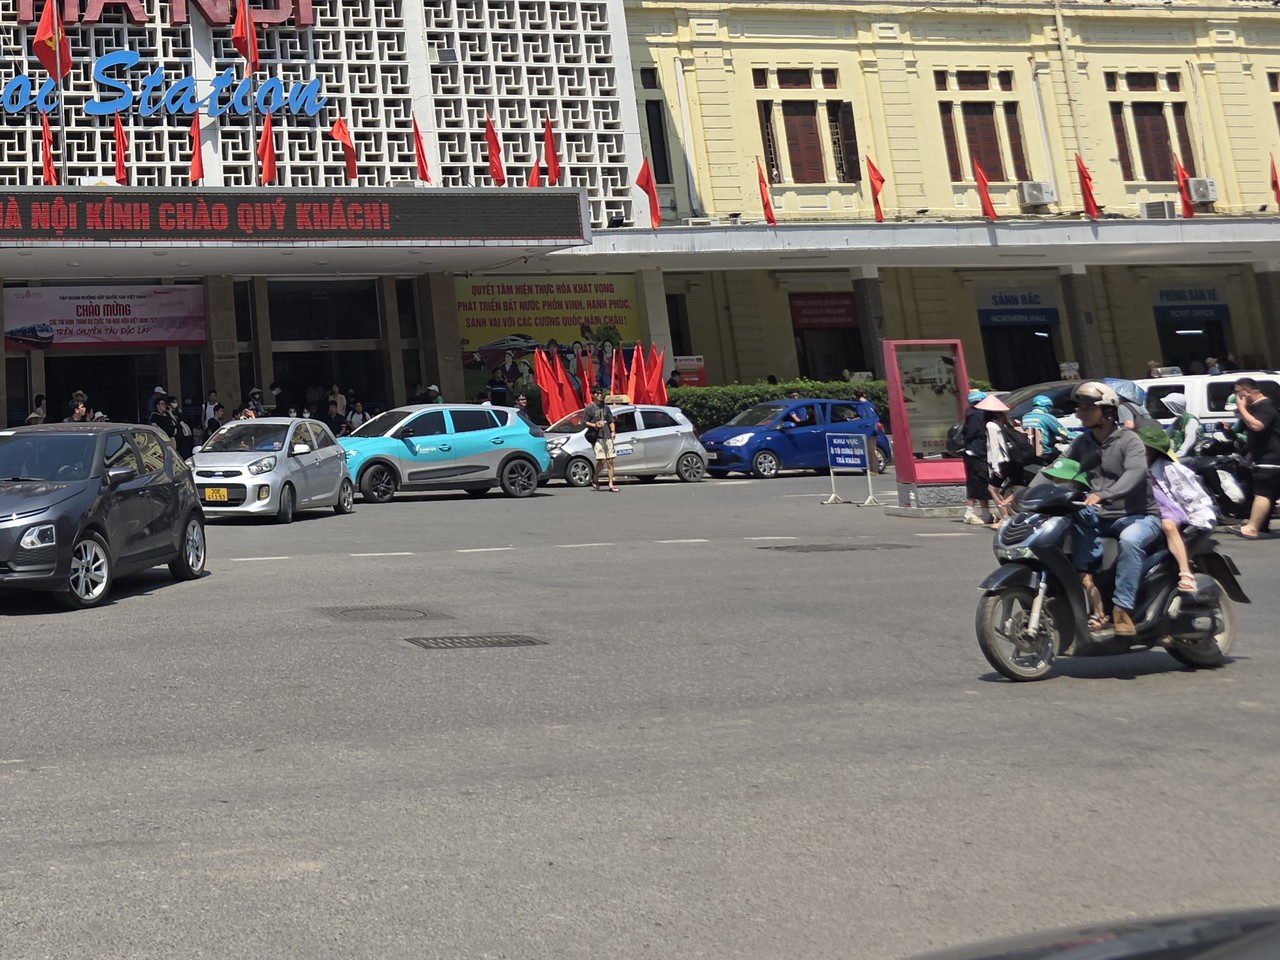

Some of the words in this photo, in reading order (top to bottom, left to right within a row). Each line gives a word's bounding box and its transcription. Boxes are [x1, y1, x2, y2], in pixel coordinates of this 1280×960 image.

[83, 50, 328, 118] Station
[30, 195, 78, 236] NỘI
[86, 196, 150, 230] KÍNH
[158, 196, 230, 231] CHÀO
[236, 196, 287, 234] QUÝ
[295, 196, 392, 231] KHÁCH!
[471, 282, 495, 296] QUYẾT
[496, 283, 513, 295] TÂM
[515, 283, 533, 297] HIỆN
[534, 283, 554, 296] THỰC
[556, 282, 572, 294] HÓA
[573, 282, 592, 294] KHÁT
[593, 283, 614, 296] VỌNG
[76, 301, 100, 317] CHÀO
[102, 301, 131, 317] MỪNG
[457, 299, 477, 312] PHÁT
[478, 298, 500, 312] TRIỂN
[503, 298, 517, 311] ĐẤT
[520, 299, 540, 311] NƯỚC
[542, 298, 563, 311] PHỒN
[586, 299, 607, 312] HẠNH
[465, 315, 487, 328] SÁNH
[489, 317, 501, 328] VAI
[502, 316, 516, 328] VỚI
[517, 315, 533, 327] CÁC
[534, 315, 560, 327] CƯỜNG
[562, 314, 581, 326] QUỐC
